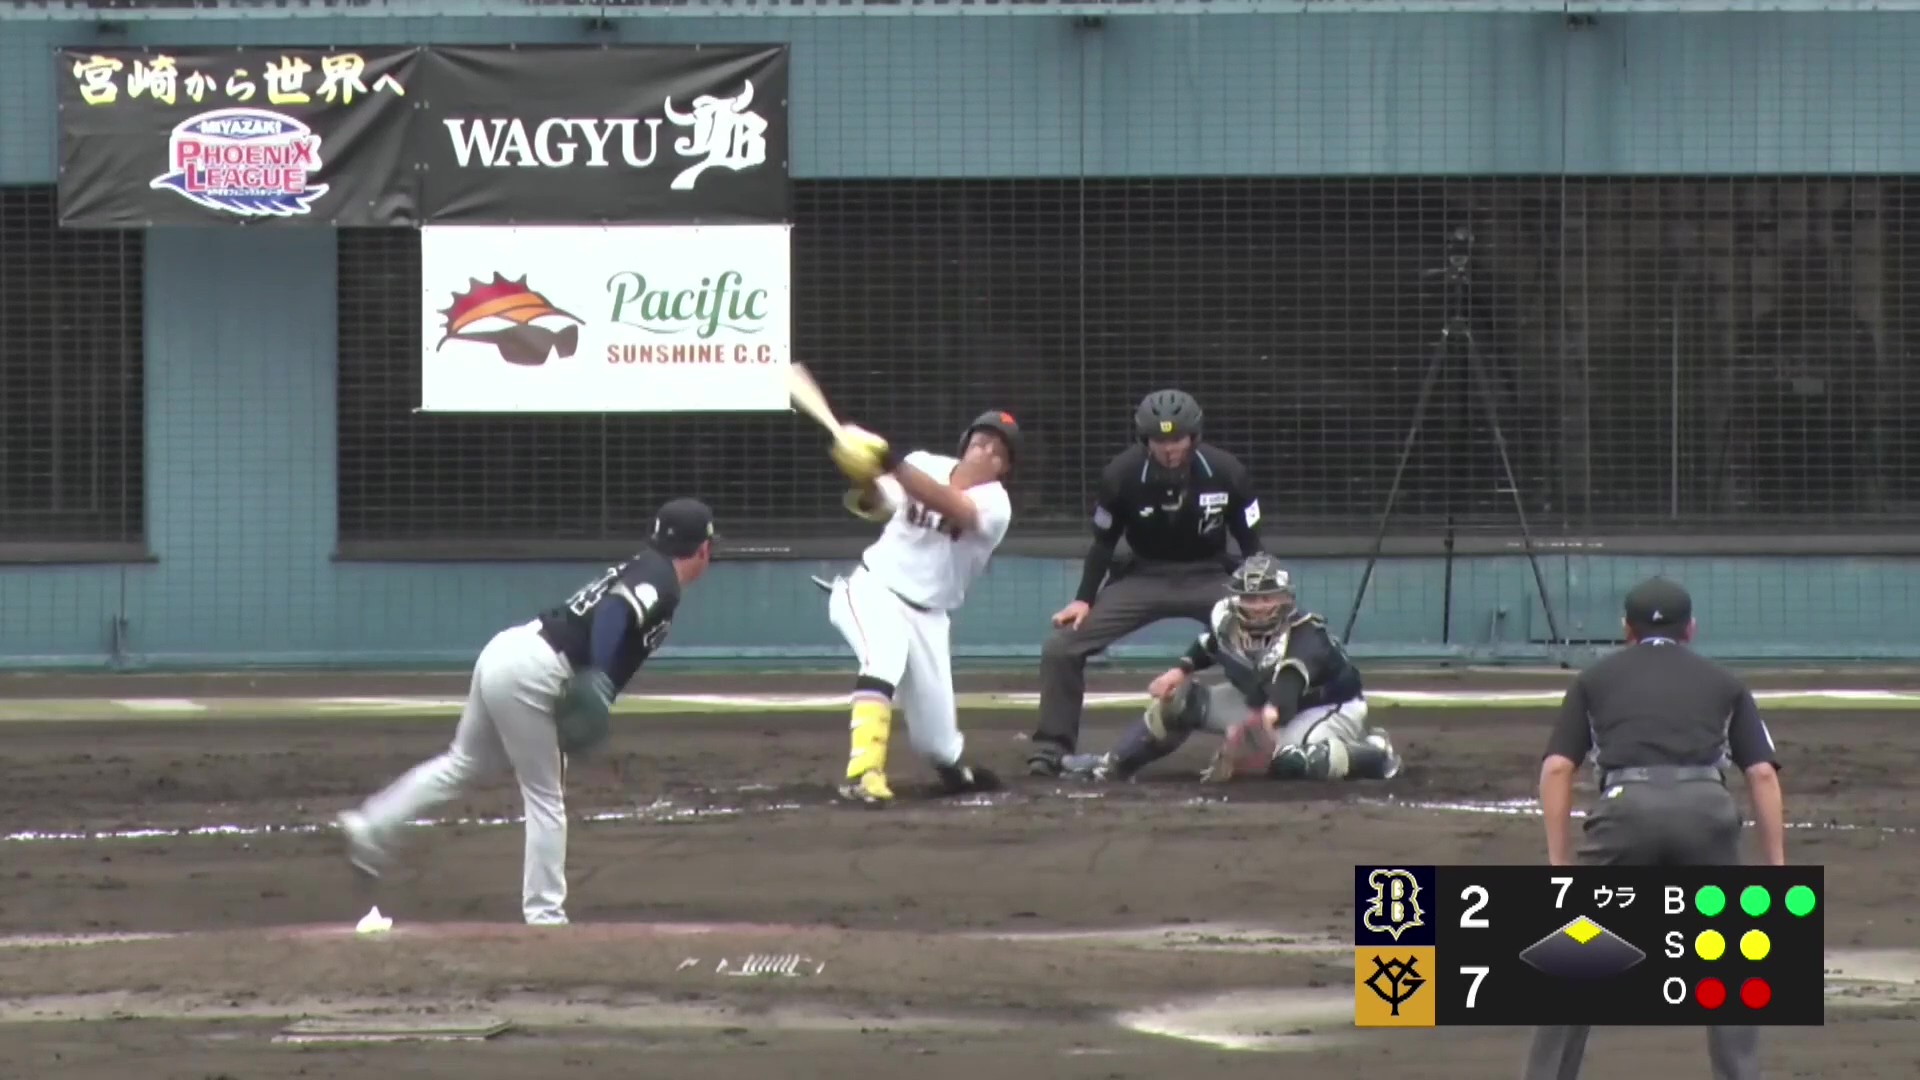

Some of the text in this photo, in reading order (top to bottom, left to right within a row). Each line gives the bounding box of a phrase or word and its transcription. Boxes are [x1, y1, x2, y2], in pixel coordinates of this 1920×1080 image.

[72, 54, 405, 105] 宮崎から世界へ
[200, 118, 282, 136] MIYAZAKI
[443, 118, 663, 168] WAGYU
[176, 139, 313, 166] PHOENIX
[185, 162, 306, 194] LEAGUE
[606, 270, 768, 340] Pacific
[607, 344, 777, 364] SUNSHINE C.C.
